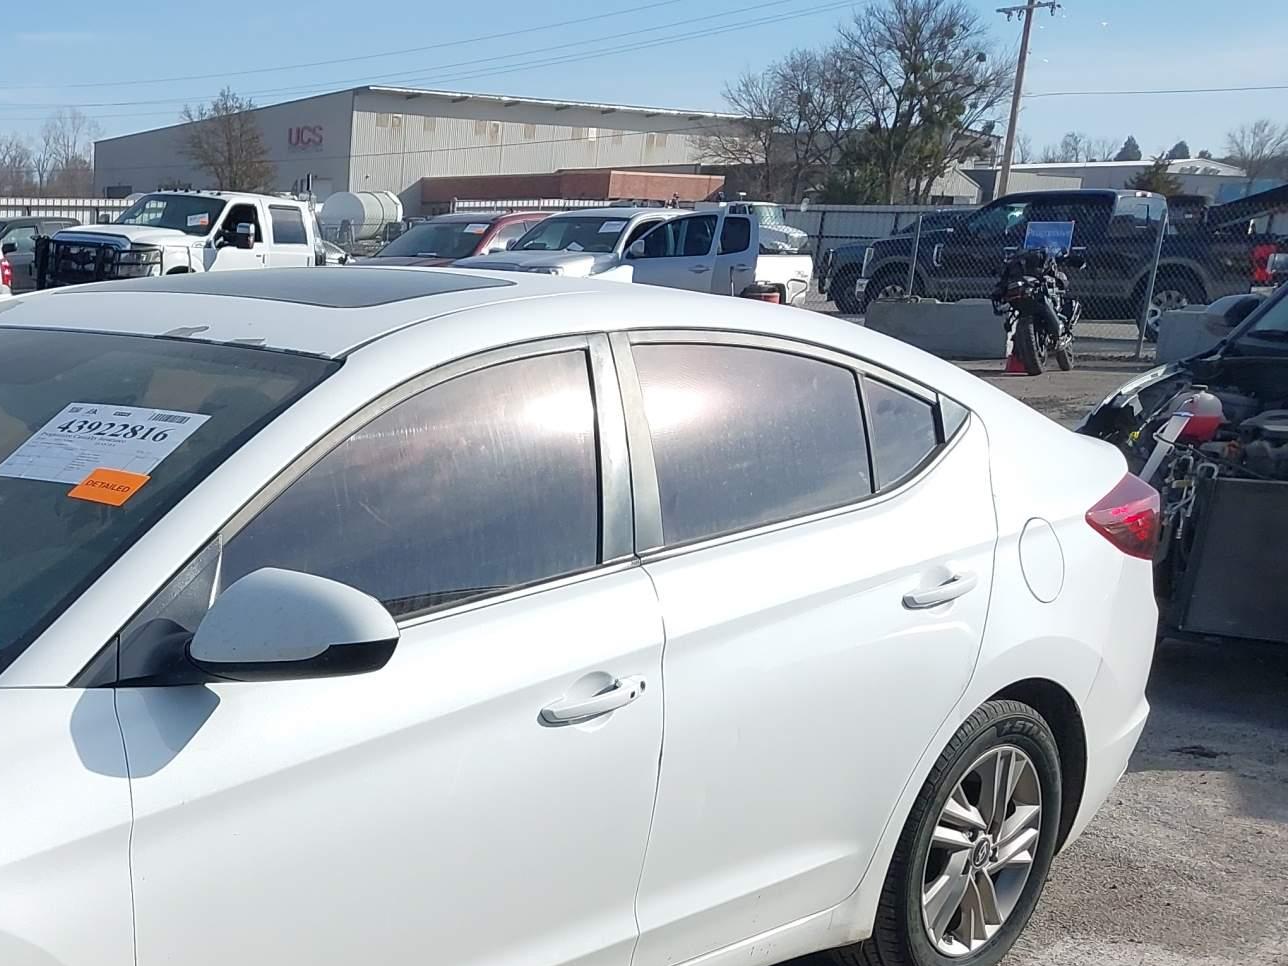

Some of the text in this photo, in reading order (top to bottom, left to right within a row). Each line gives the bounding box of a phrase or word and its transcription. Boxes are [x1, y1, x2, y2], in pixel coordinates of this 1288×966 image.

[288, 126, 323, 145] UCS
[57, 419, 175, 442] 43922816
[85, 479, 131, 493] DETAILED
